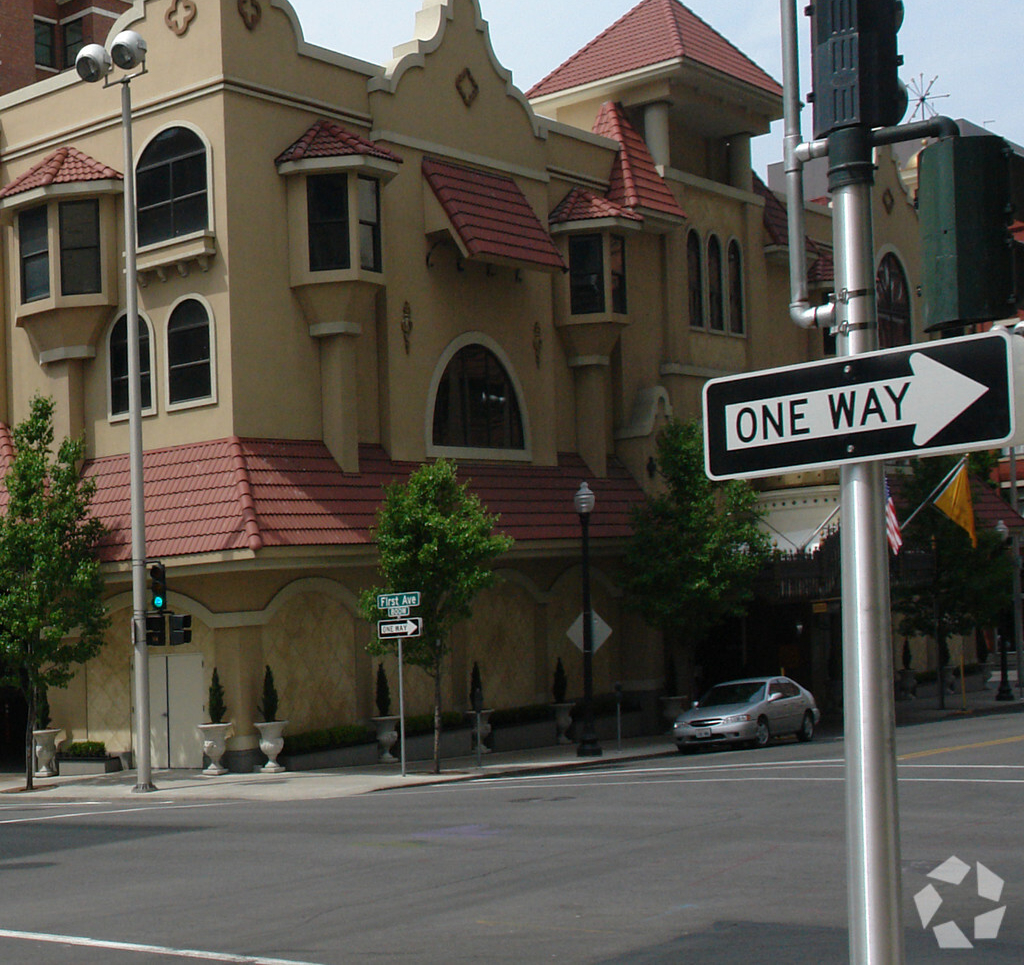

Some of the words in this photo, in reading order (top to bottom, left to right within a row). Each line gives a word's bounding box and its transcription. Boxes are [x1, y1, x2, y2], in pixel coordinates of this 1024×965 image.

[736, 398, 810, 443] ONE
[827, 381, 912, 430] WAY
[380, 596, 399, 606] First
[402, 595, 417, 605] Ave
[382, 625, 394, 633] ONE
